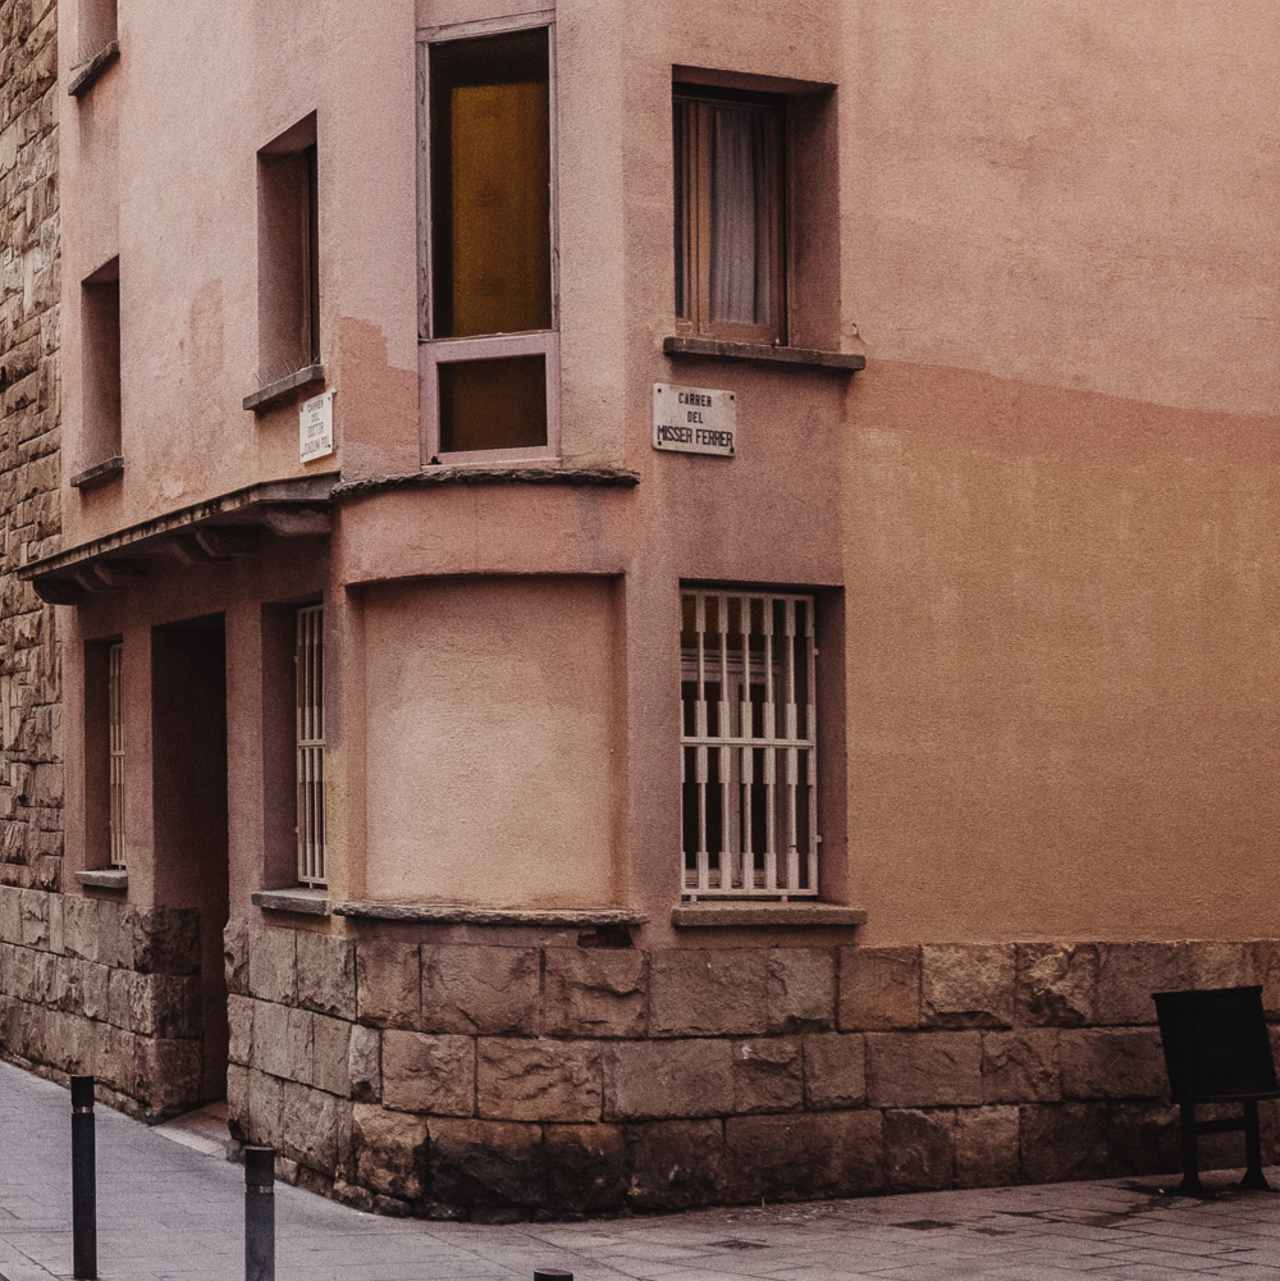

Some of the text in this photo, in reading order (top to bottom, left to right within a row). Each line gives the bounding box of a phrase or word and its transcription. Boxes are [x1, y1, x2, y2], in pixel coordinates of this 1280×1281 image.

[678, 392, 713, 408] CARRER
[687, 411, 704, 424] DEL
[657, 425, 734, 448] MISSER FERRER
